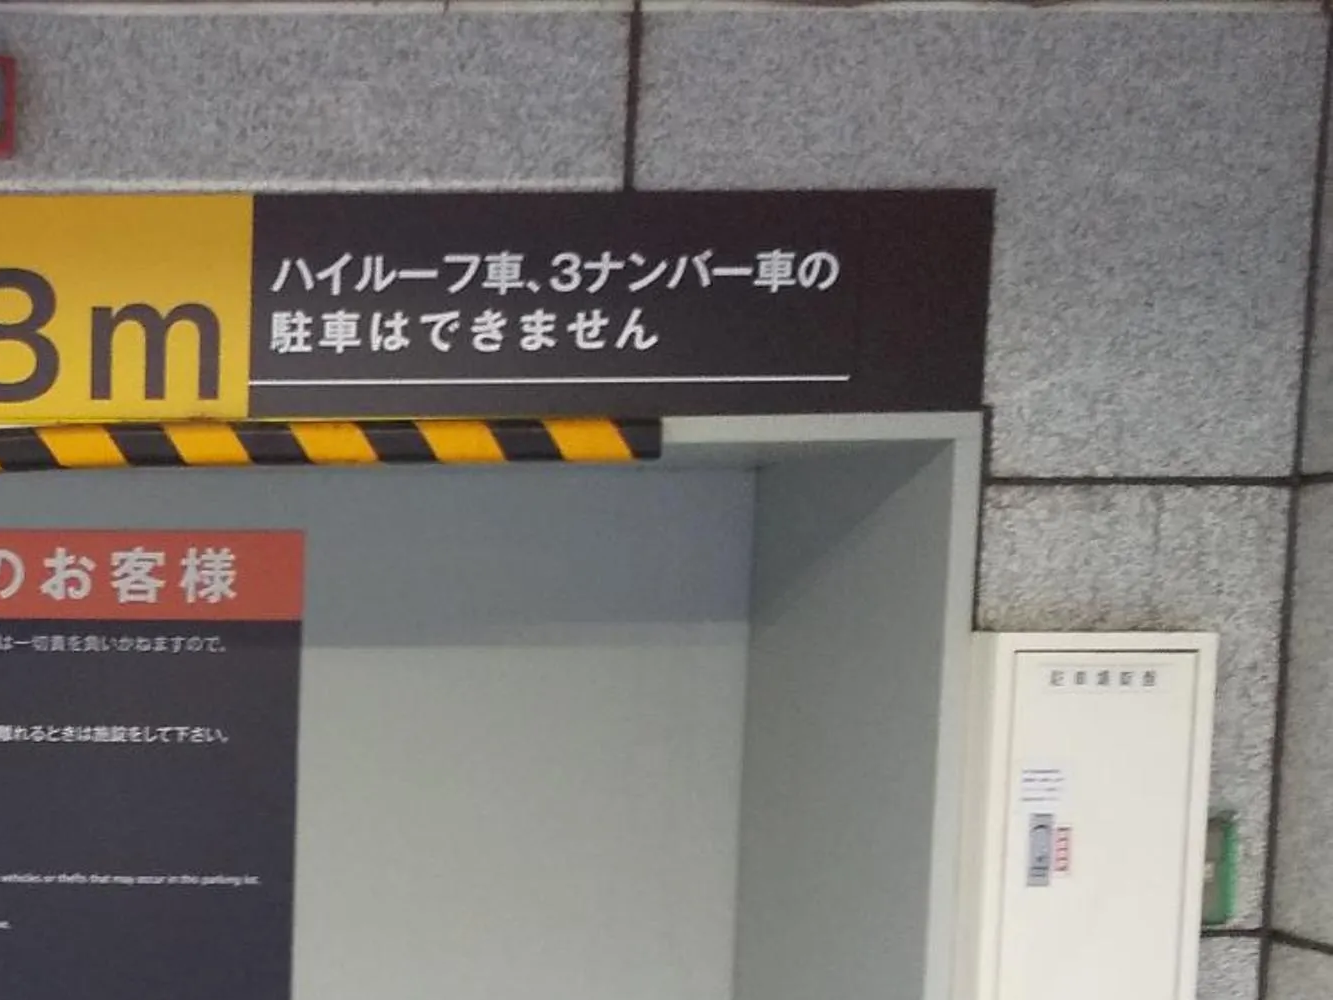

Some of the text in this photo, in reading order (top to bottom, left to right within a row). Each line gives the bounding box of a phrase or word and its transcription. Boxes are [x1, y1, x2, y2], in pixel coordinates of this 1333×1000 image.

[269, 248, 841, 296] ハイルーフ車、3ナンバー車の
[269, 307, 659, 354] 駐車はできません
